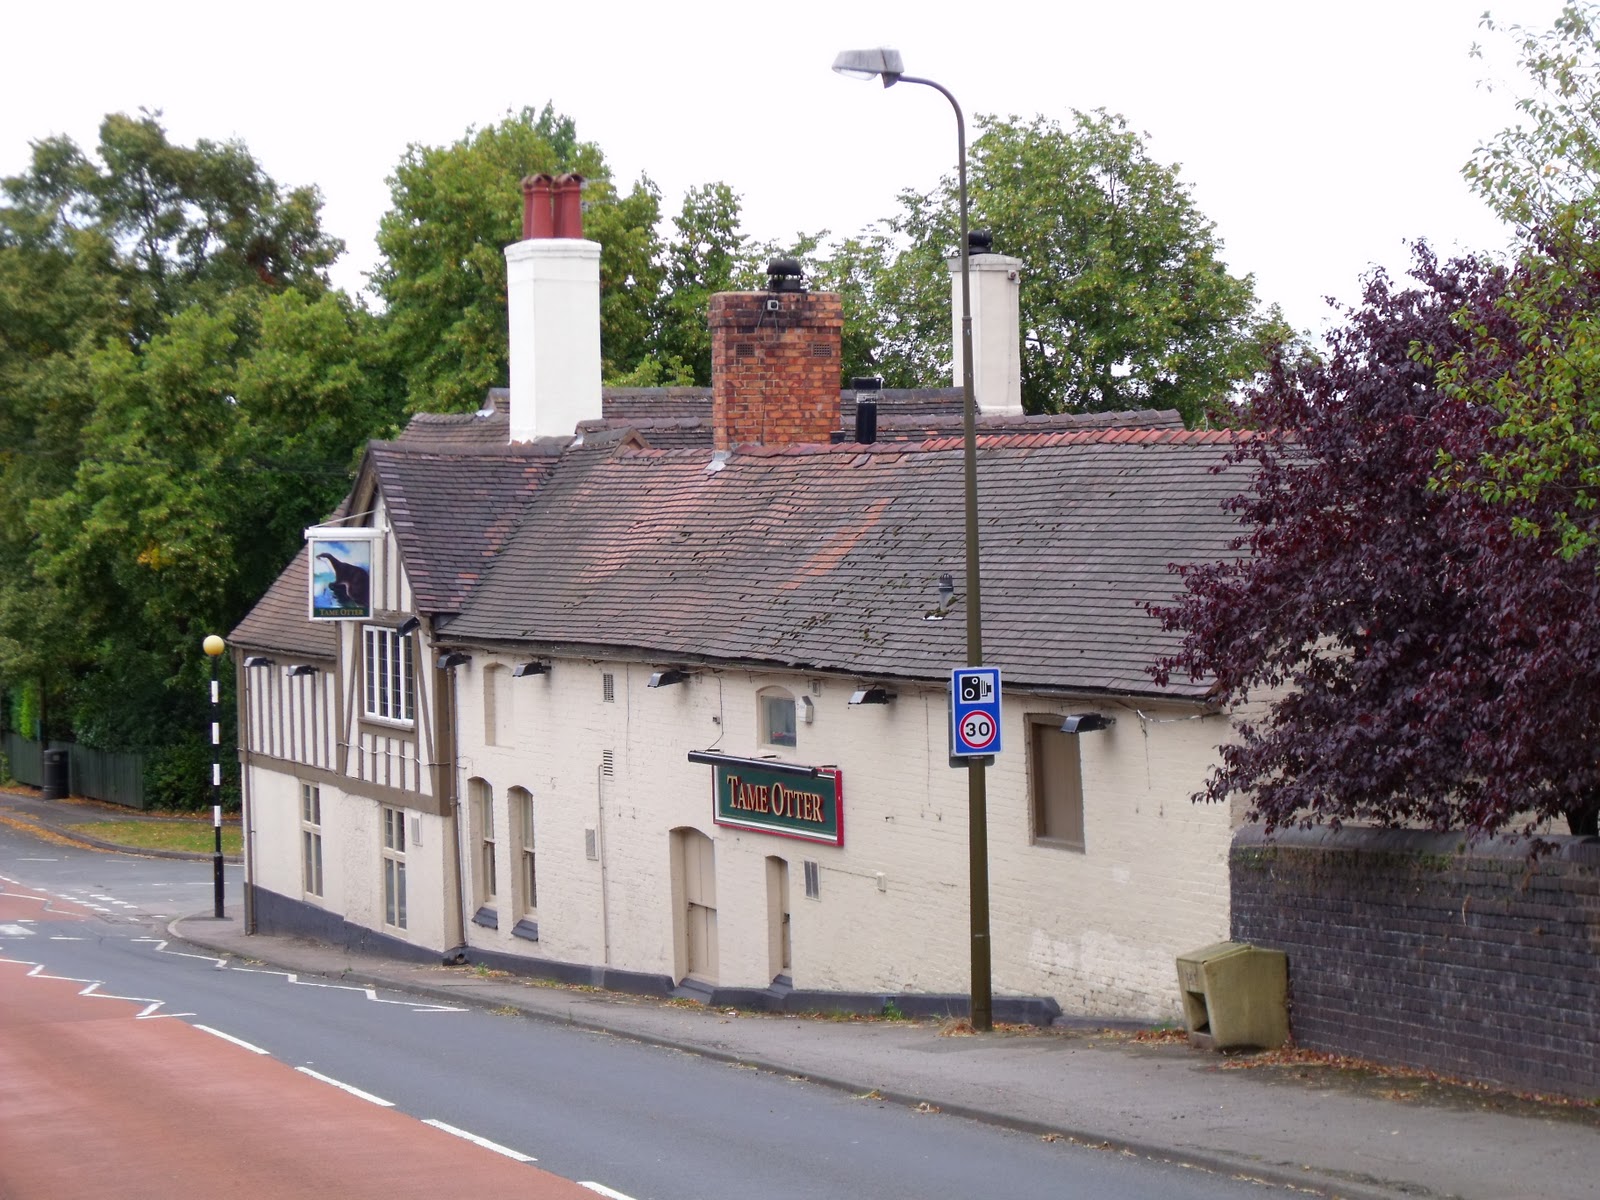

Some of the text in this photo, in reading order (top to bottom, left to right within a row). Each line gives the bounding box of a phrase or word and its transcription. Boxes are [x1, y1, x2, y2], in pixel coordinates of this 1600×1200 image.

[340, 608, 364, 616] OTTER
[965, 722, 990, 737] 30
[727, 775, 823, 822] TAME OTTER
